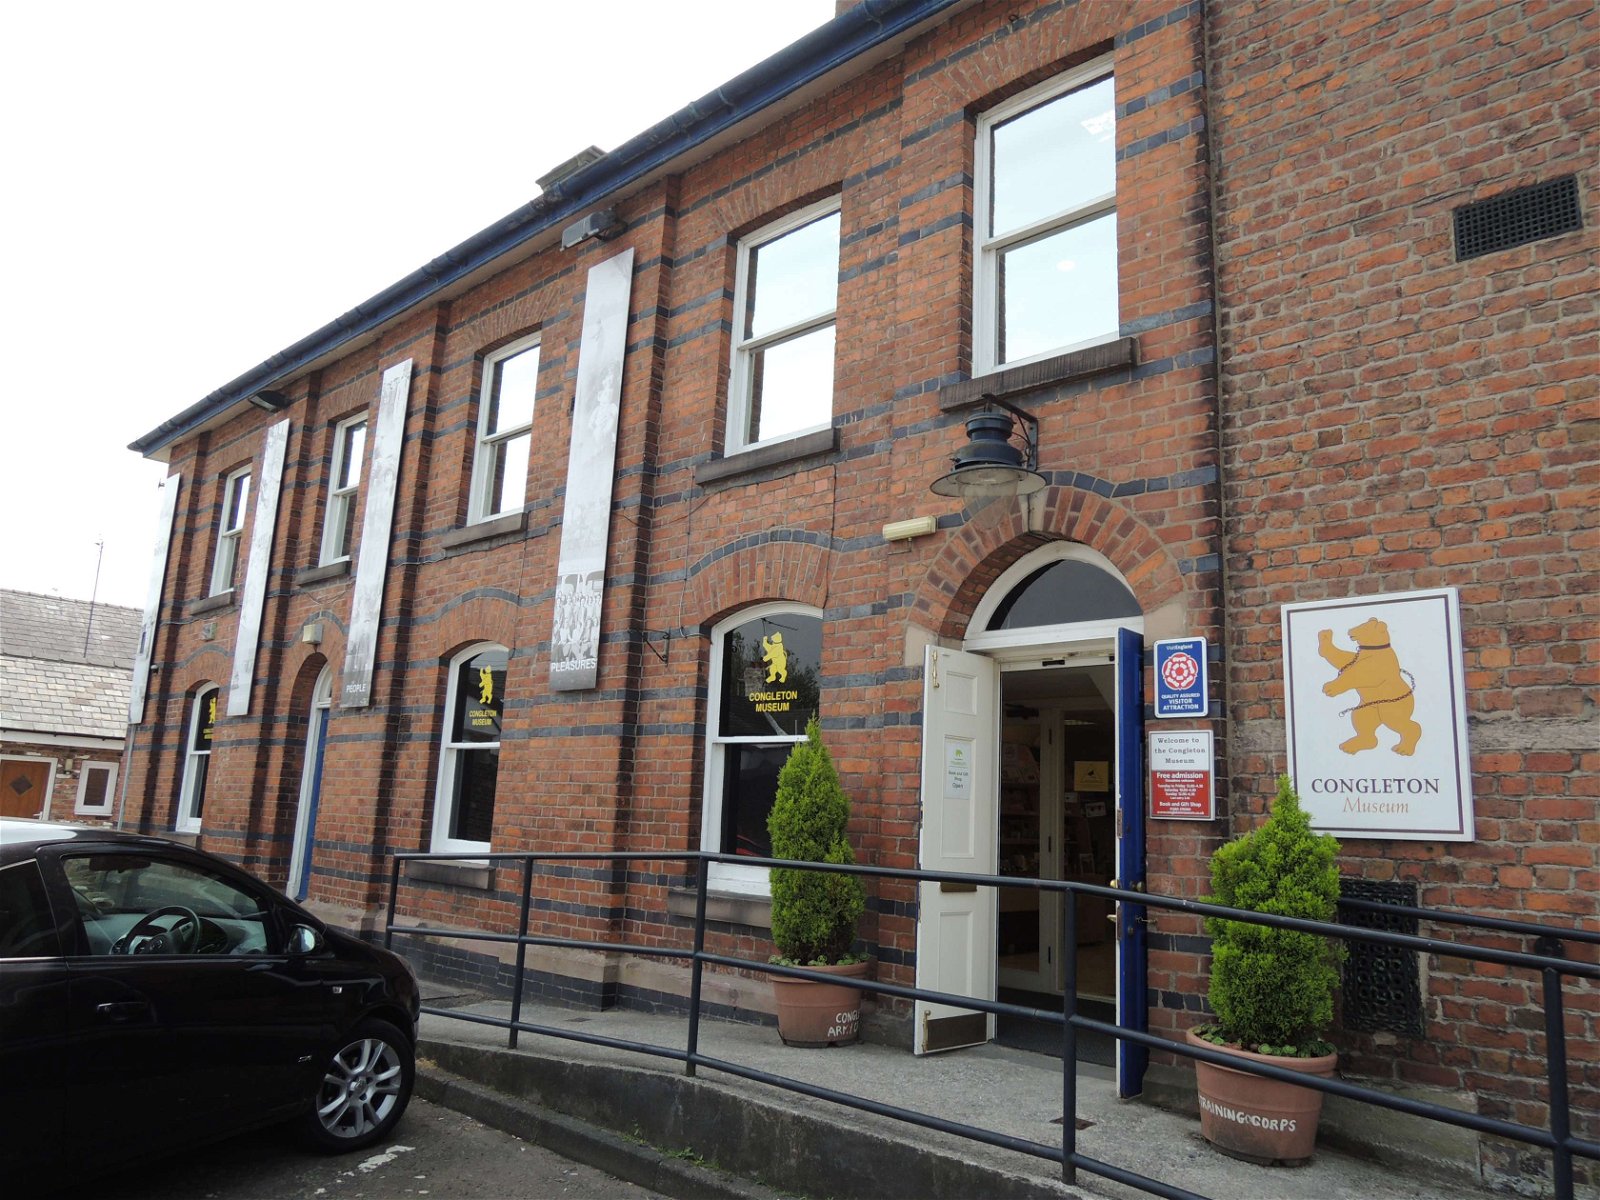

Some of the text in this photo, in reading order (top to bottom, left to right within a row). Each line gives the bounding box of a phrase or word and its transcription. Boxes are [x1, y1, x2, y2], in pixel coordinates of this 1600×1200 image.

[550, 658, 597, 673] PLEASURES
[345, 683, 367, 693] PEOPLE
[748, 690, 798, 702] CONGLETON
[755, 702, 790, 713] MUSEUM
[1162, 703, 1199, 711] ATTRACTION
[468, 709, 497, 718] CONGLETON
[471, 718, 493, 726] MUSEUM
[1168, 747, 1206, 755] Congleton
[1311, 778, 1441, 795] CONGLETON
[1343, 797, 1409, 814] Museum
[1250, 1115, 1296, 1132] CORPS
